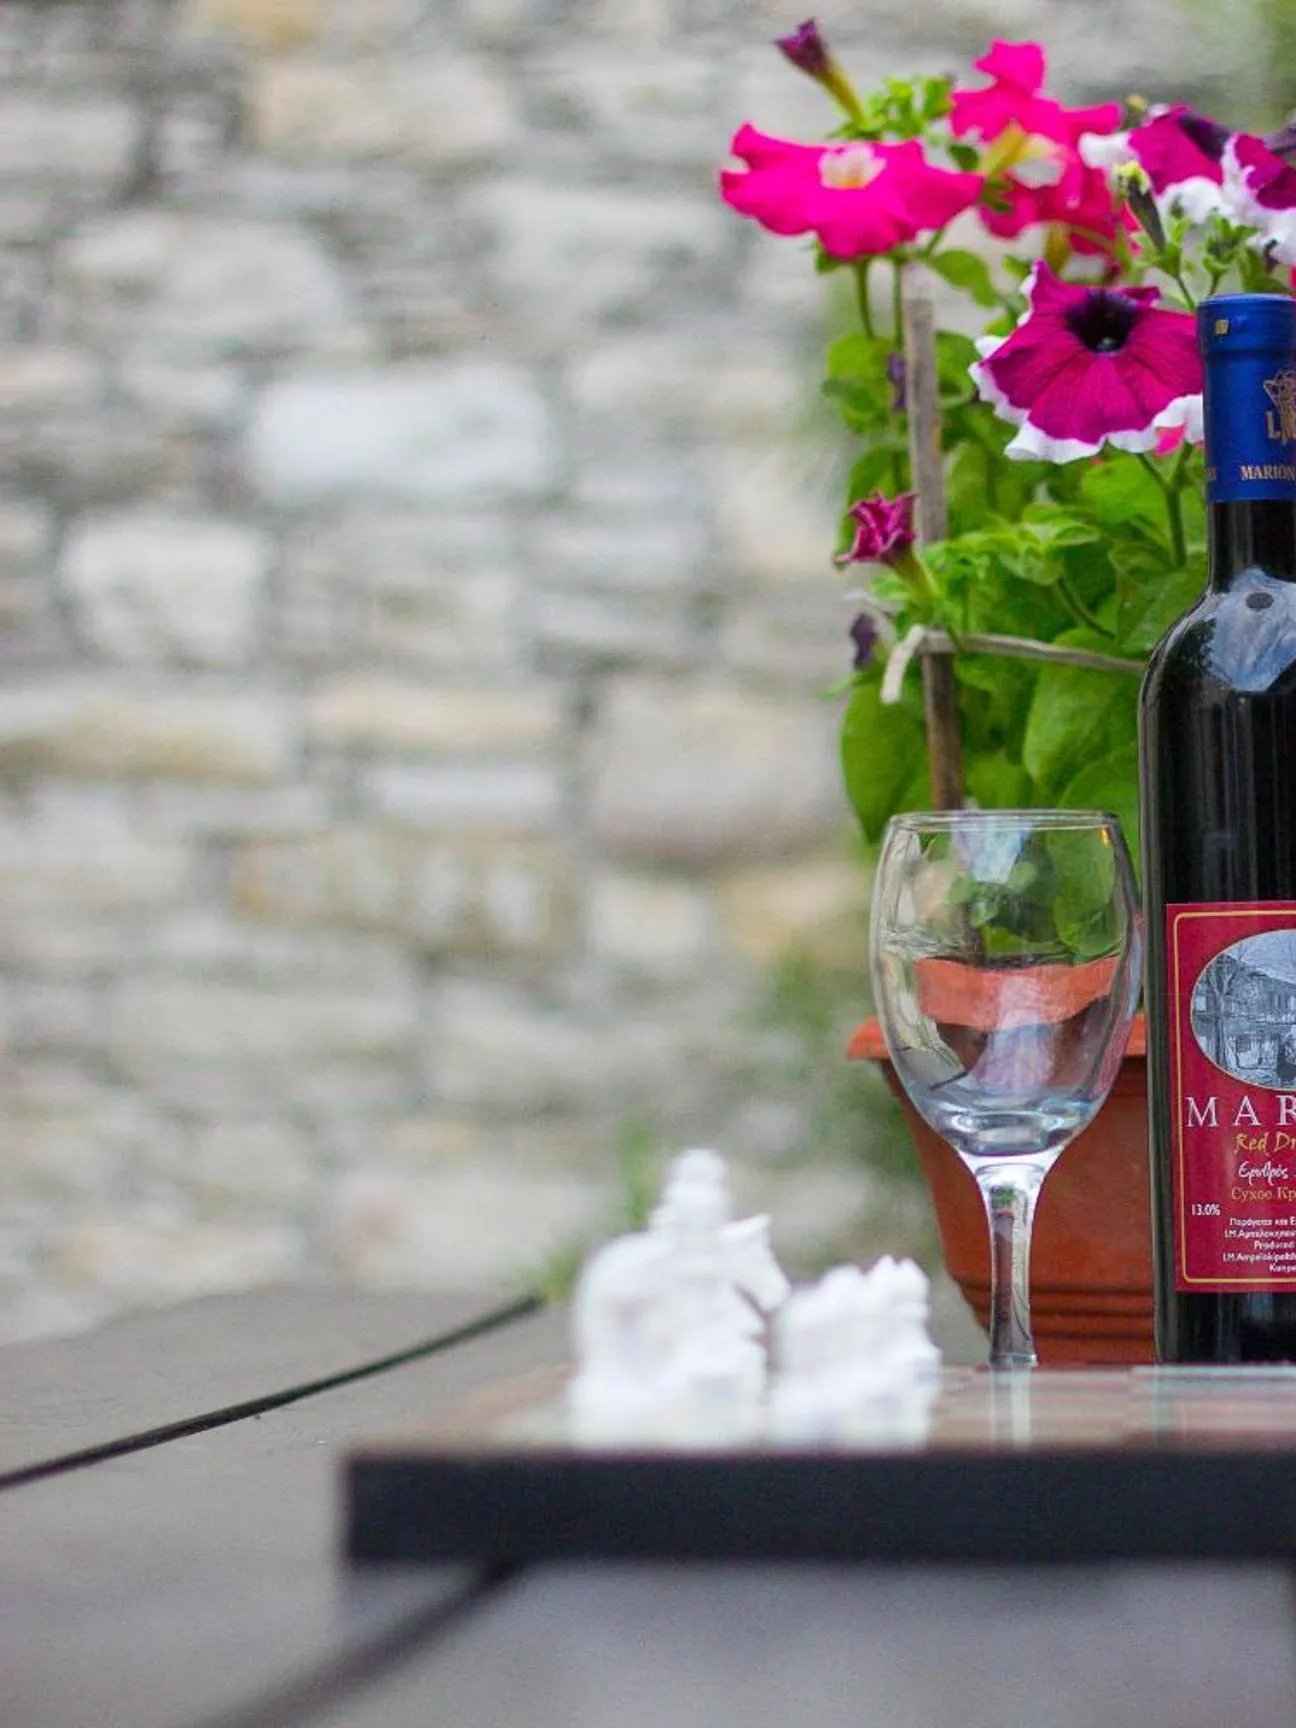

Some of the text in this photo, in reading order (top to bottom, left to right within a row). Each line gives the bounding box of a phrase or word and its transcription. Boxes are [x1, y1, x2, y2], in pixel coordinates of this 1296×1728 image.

[1241, 465, 1296, 481] MARION
[1234, 1131, 1270, 1156] Red
[1231, 1187, 1272, 1201] Сухое
[1191, 1203, 1220, 1216] 13.0%
[1253, 1240, 1294, 1249] Produced
